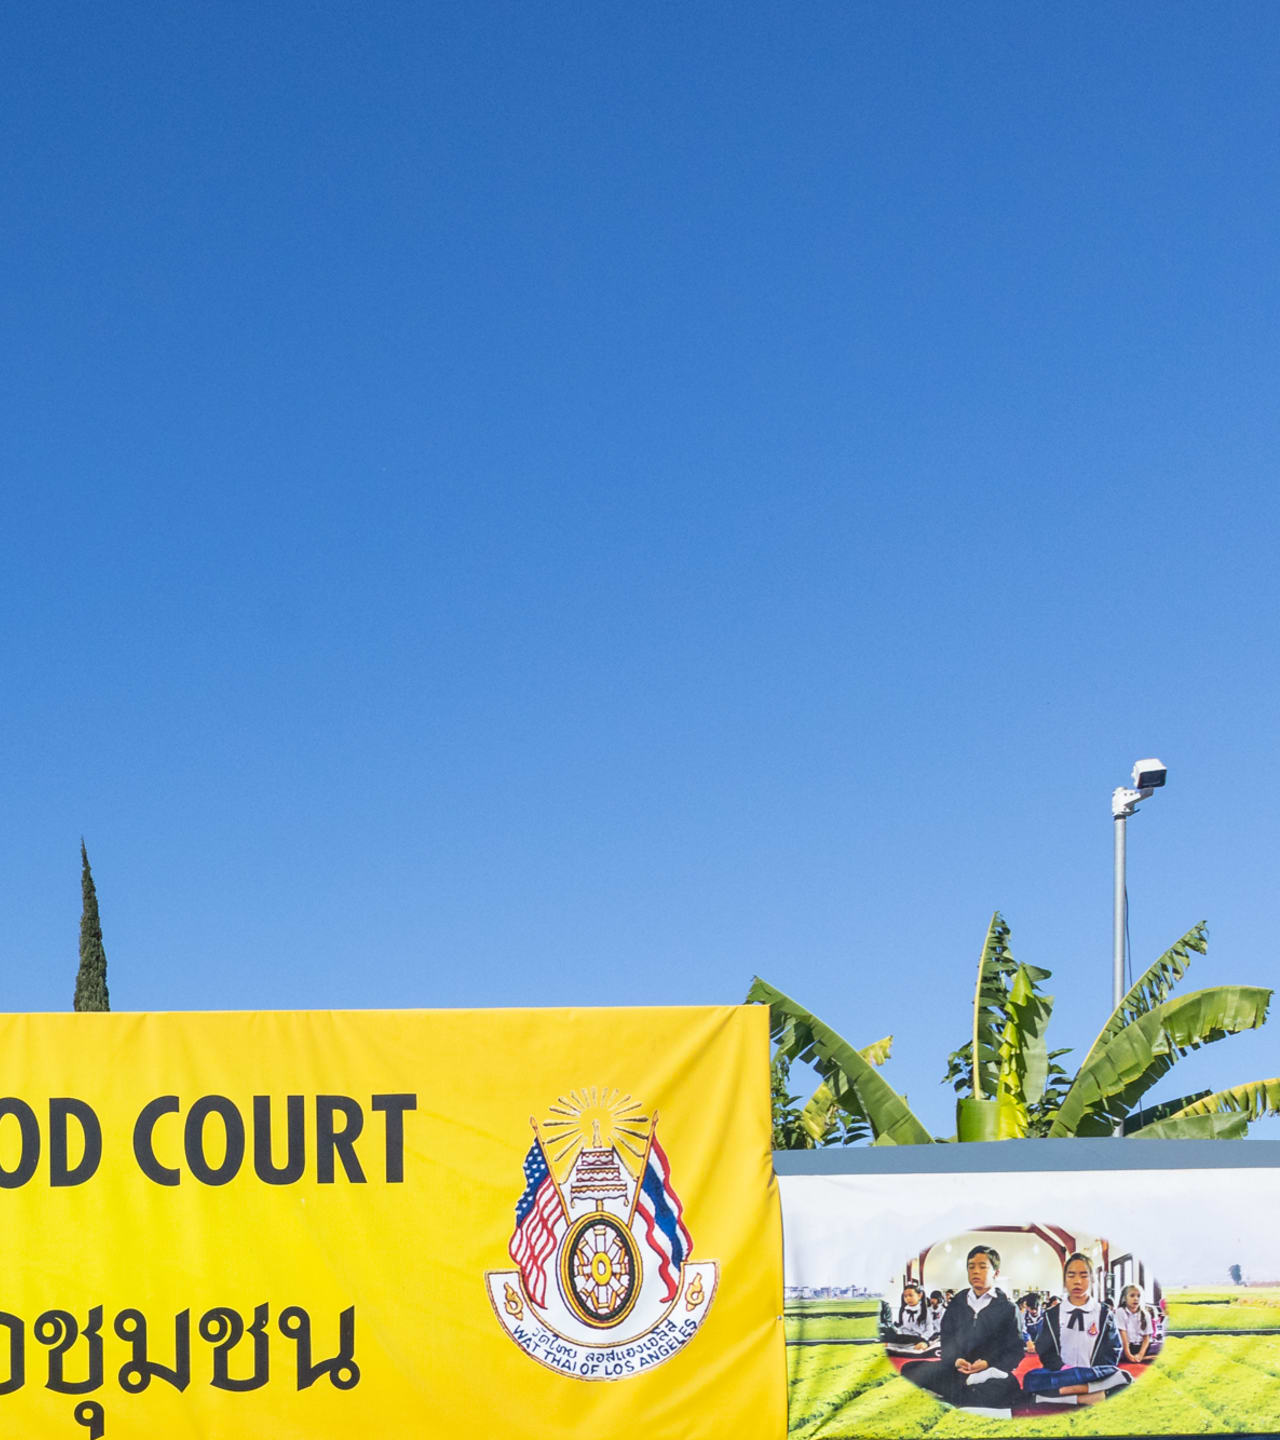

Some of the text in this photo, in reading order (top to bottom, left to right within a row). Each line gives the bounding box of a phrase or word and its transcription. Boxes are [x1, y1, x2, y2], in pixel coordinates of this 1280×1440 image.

[133, 1093, 417, 1187] COURT
[512, 1318, 698, 1376] WAT THAI OF LOS ANGELES
